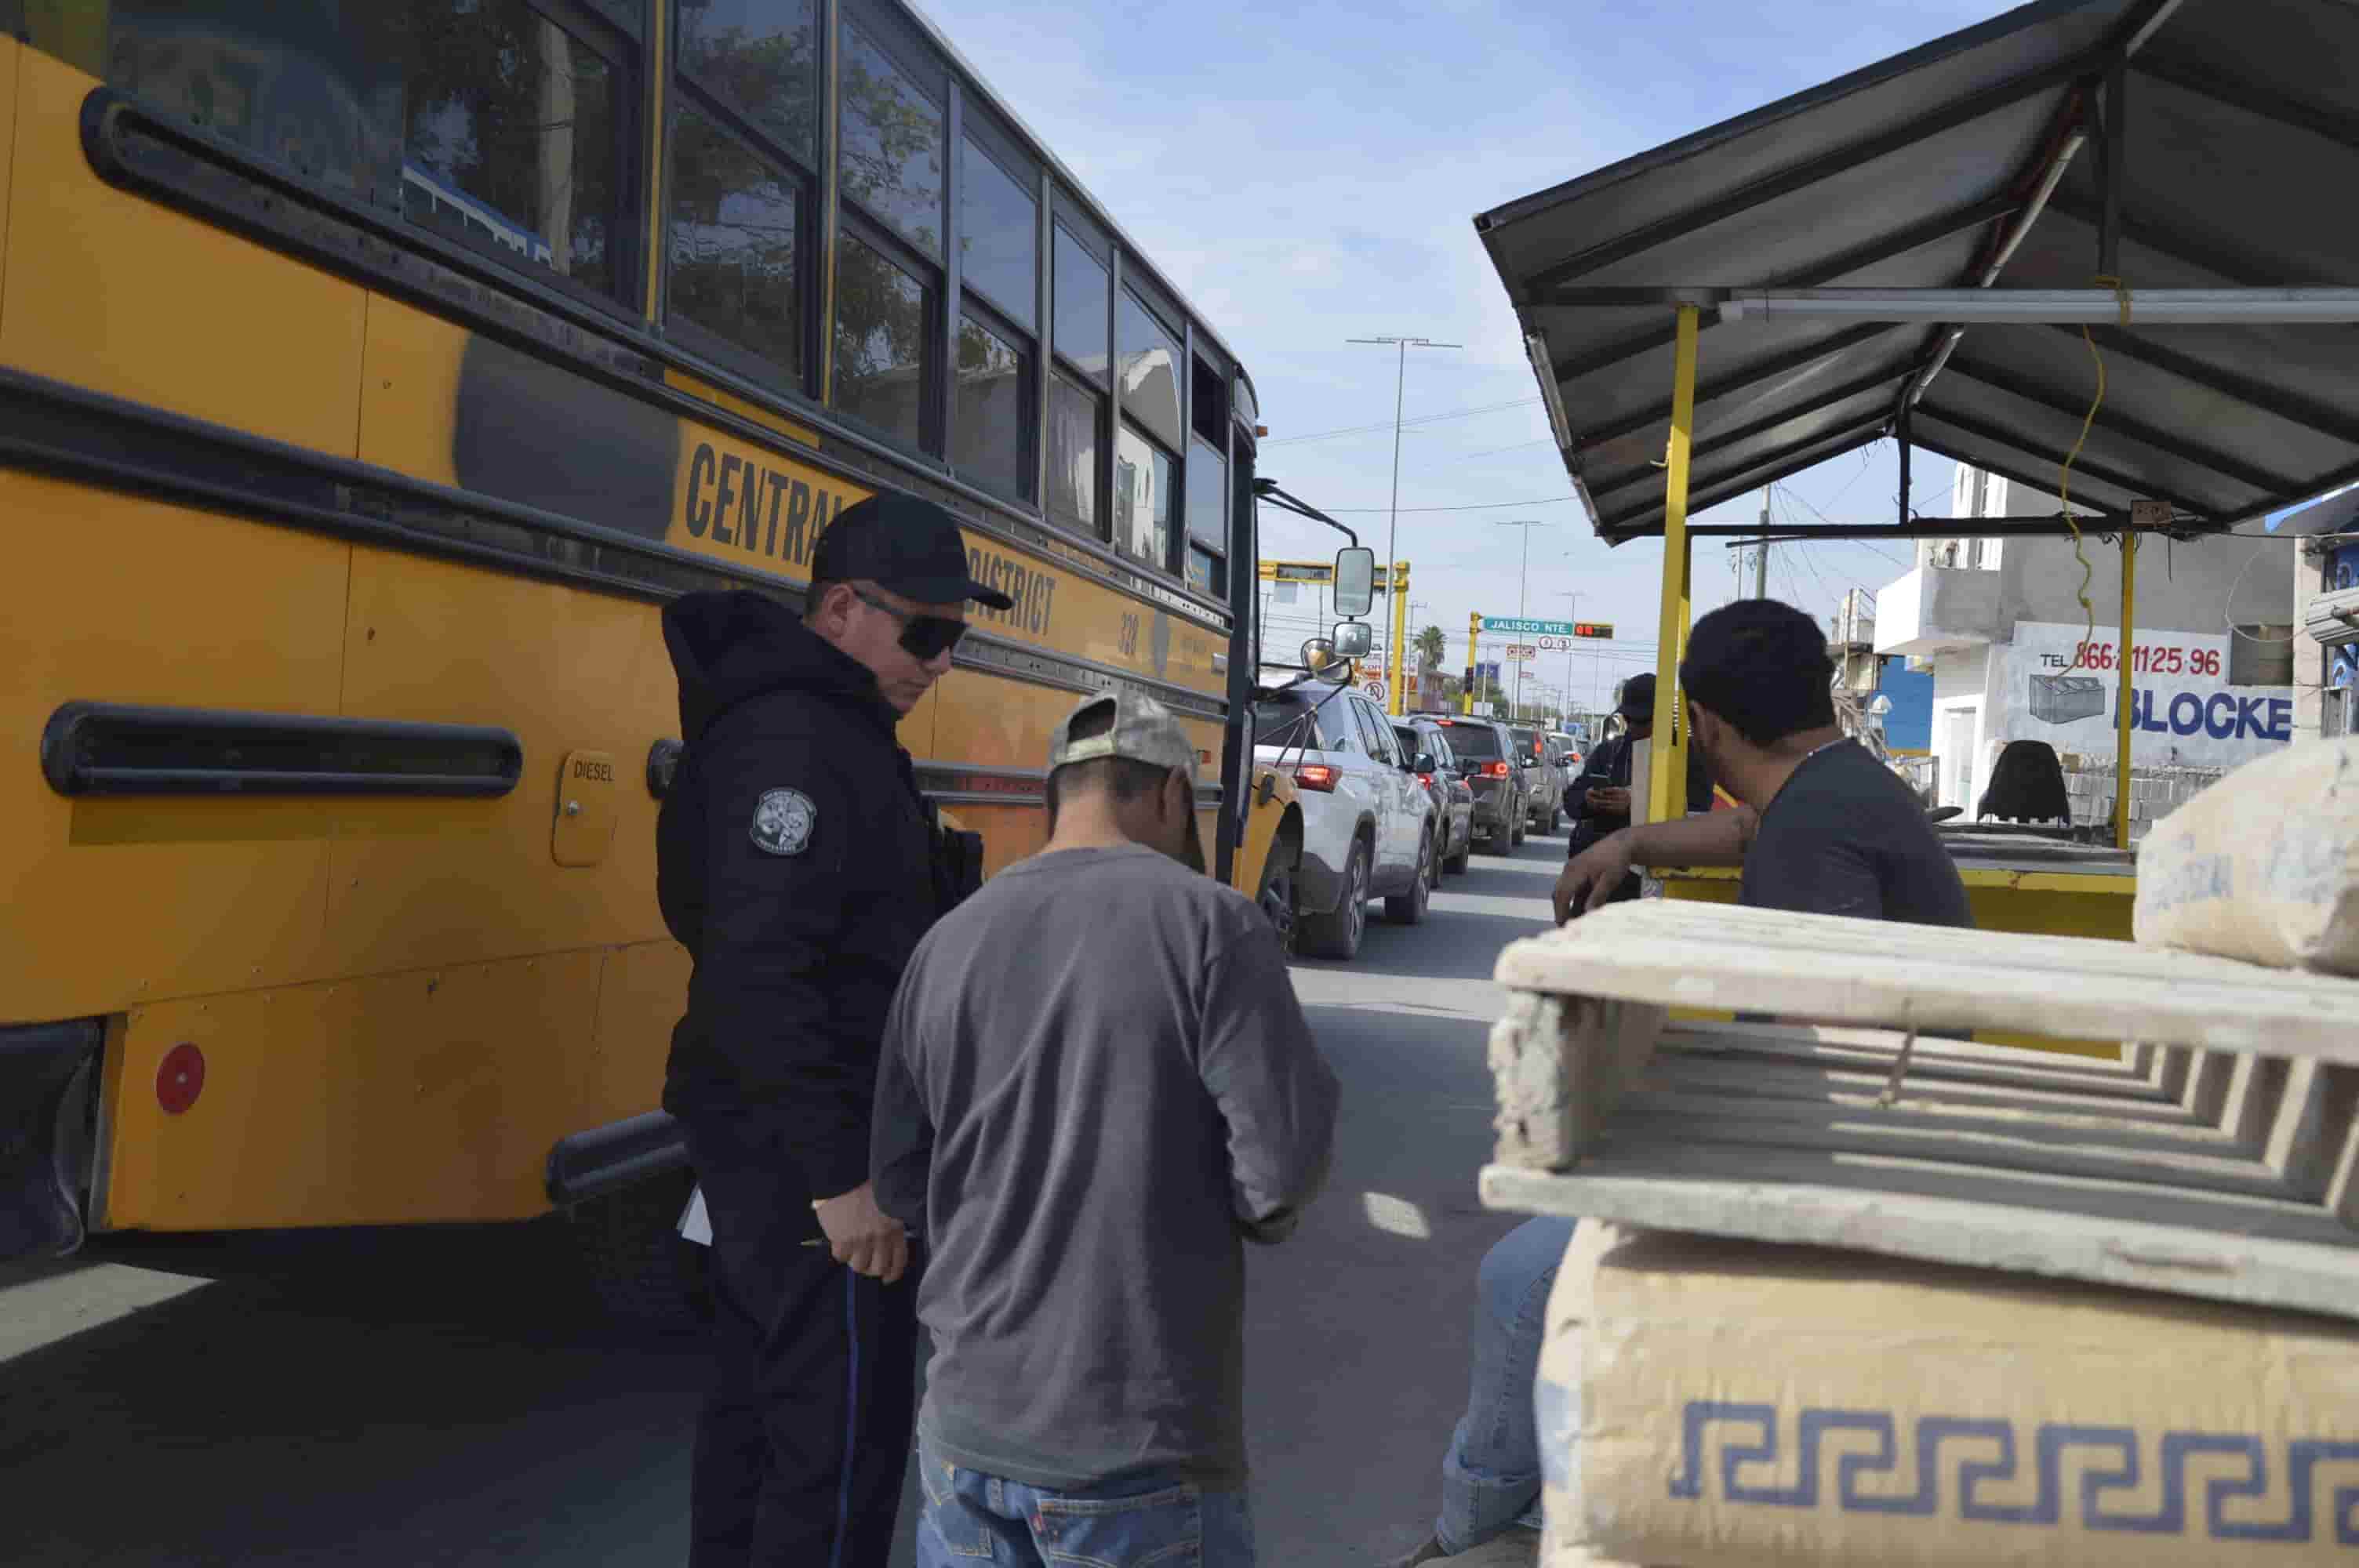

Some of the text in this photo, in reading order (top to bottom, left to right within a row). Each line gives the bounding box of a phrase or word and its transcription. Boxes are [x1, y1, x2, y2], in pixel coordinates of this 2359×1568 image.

[686, 442, 1056, 637] CENTRA DISTRICT
[1492, 619, 1539, 632] JALISCO
[574, 760, 614, 782] DIESEL
